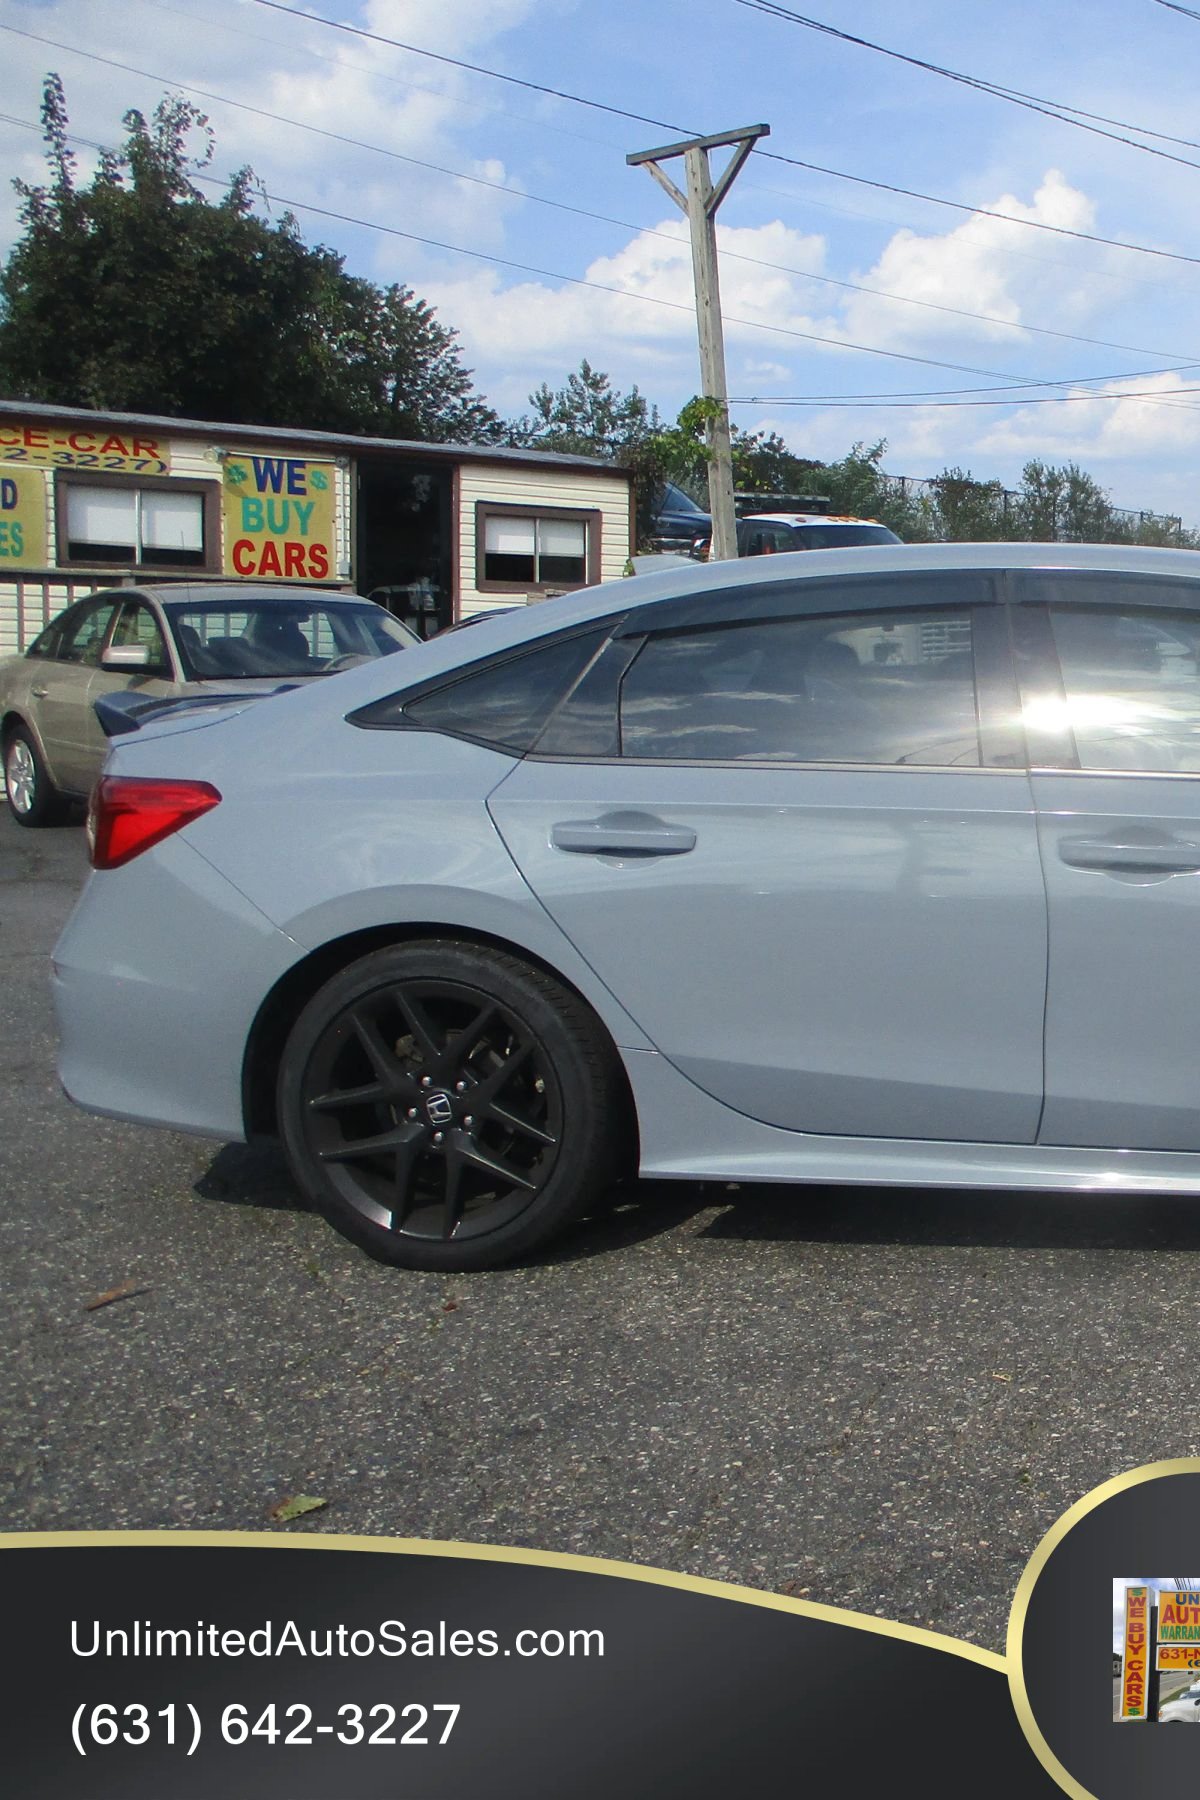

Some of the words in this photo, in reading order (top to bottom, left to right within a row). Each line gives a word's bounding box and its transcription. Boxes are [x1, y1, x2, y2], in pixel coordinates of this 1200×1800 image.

[252, 457, 307, 495] WE
[242, 496, 316, 536] BUY
[232, 538, 329, 579] CARS
